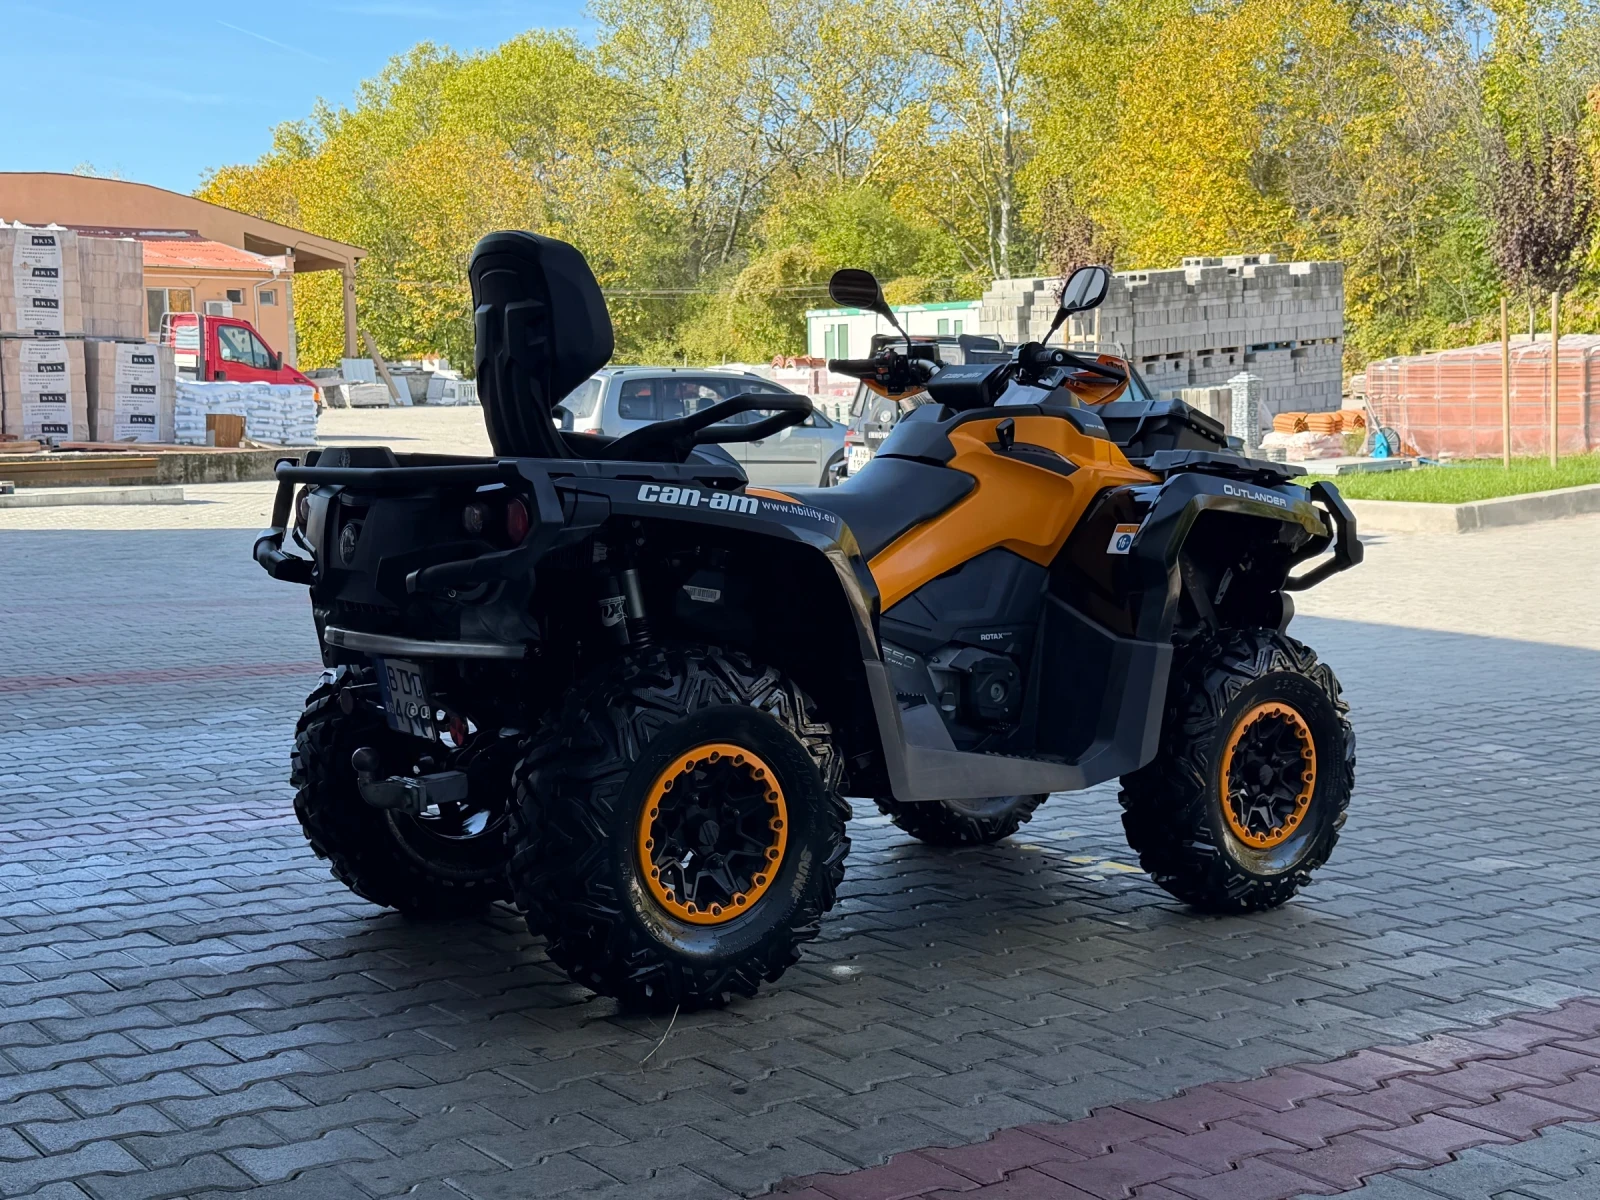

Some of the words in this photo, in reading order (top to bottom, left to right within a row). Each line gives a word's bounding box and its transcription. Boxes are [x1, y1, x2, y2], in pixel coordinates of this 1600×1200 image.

[637, 484, 759, 515] can-am
[1223, 484, 1287, 507] OUTLANDER
[761, 501, 836, 524] www.hbility.eu
[980, 632, 1004, 641] ROTAX
